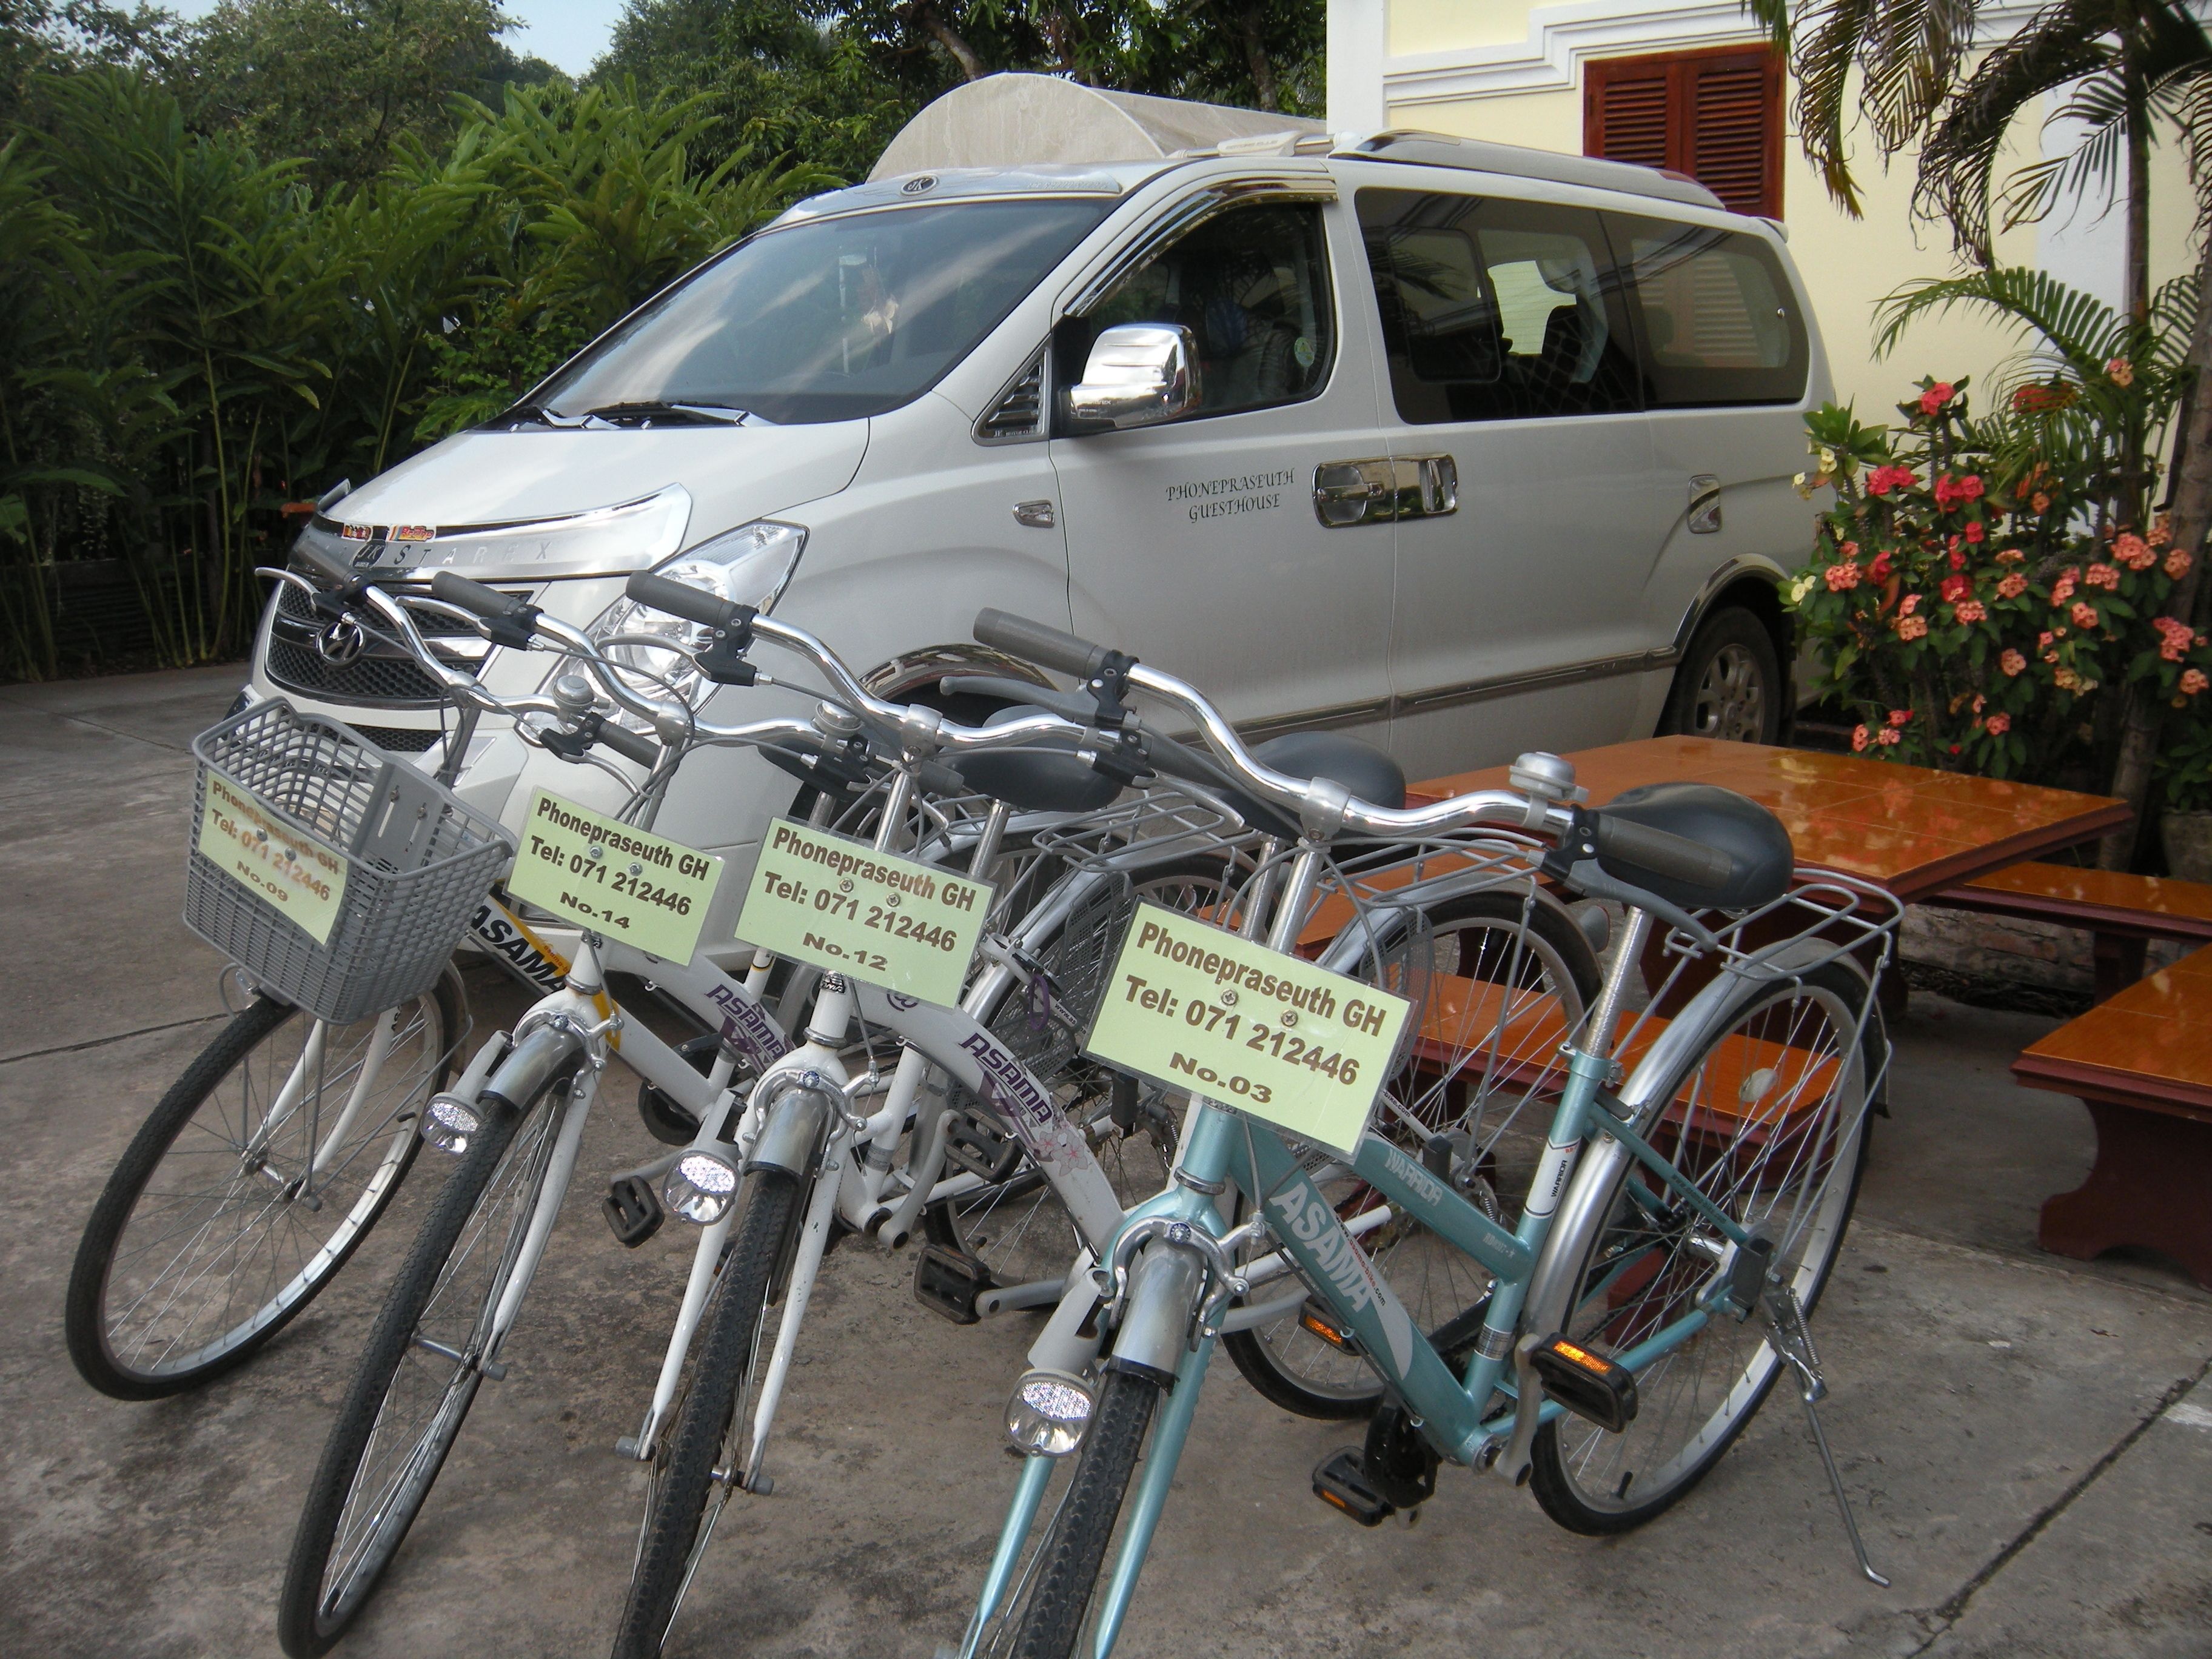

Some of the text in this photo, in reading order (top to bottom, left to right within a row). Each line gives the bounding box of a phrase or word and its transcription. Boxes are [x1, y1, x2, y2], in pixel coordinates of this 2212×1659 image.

[1166, 468, 1295, 501] PHONEPRASEUTH
[1189, 494, 1280, 523] GUESTHOUSE
[394, 541, 552, 566] STAREX
[212, 808, 330, 901] Tel: 071 212446
[317, 851, 338, 874] GH
[531, 835, 691, 916] Tel: 071 212446
[537, 797, 709, 880] Phonepraseuth GH
[773, 826, 976, 911] Phonepraseuth GH
[236, 860, 288, 902] No.09
[560, 891, 630, 929] No.14
[764, 871, 957, 951] Tel: 071 212446
[802, 932, 888, 971] No.12
[1137, 921, 1387, 1037] Phonepraseuth GH
[705, 984, 786, 1061] ASAMA
[1125, 974, 1360, 1085] Tel: 071 212446
[958, 1033, 1053, 1123] ASAMA
[1168, 1052, 1273, 1104] No.03
[1270, 1182, 1372, 1312] ASAMA
